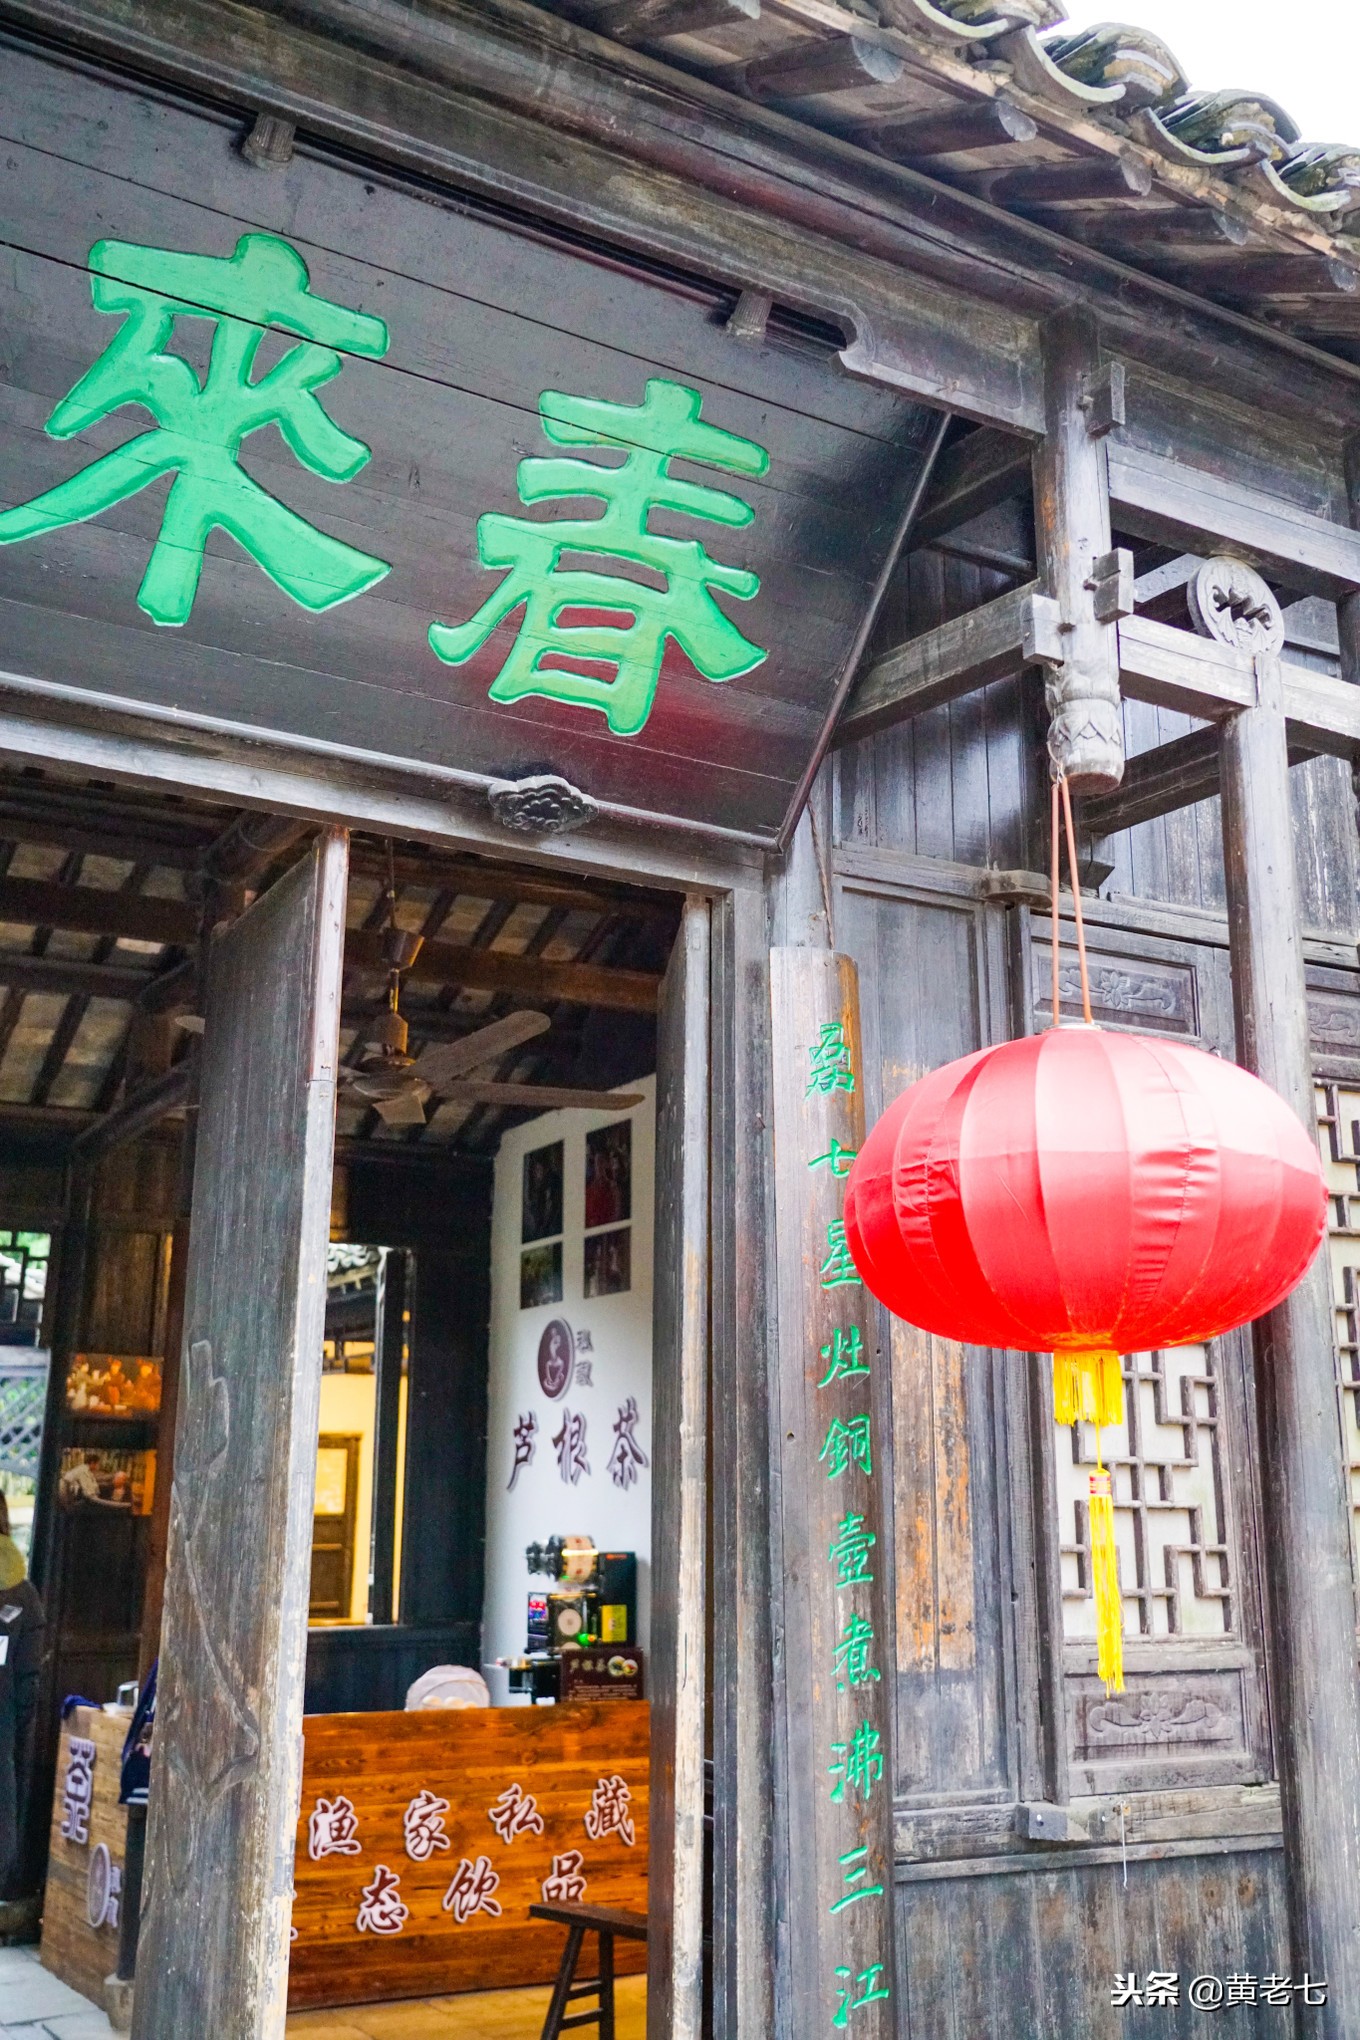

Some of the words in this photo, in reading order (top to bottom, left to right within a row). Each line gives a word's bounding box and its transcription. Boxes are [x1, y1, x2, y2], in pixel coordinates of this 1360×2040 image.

[506, 1396, 650, 1493] 芦根茶
[290, 1850, 587, 1940] 态饮品
